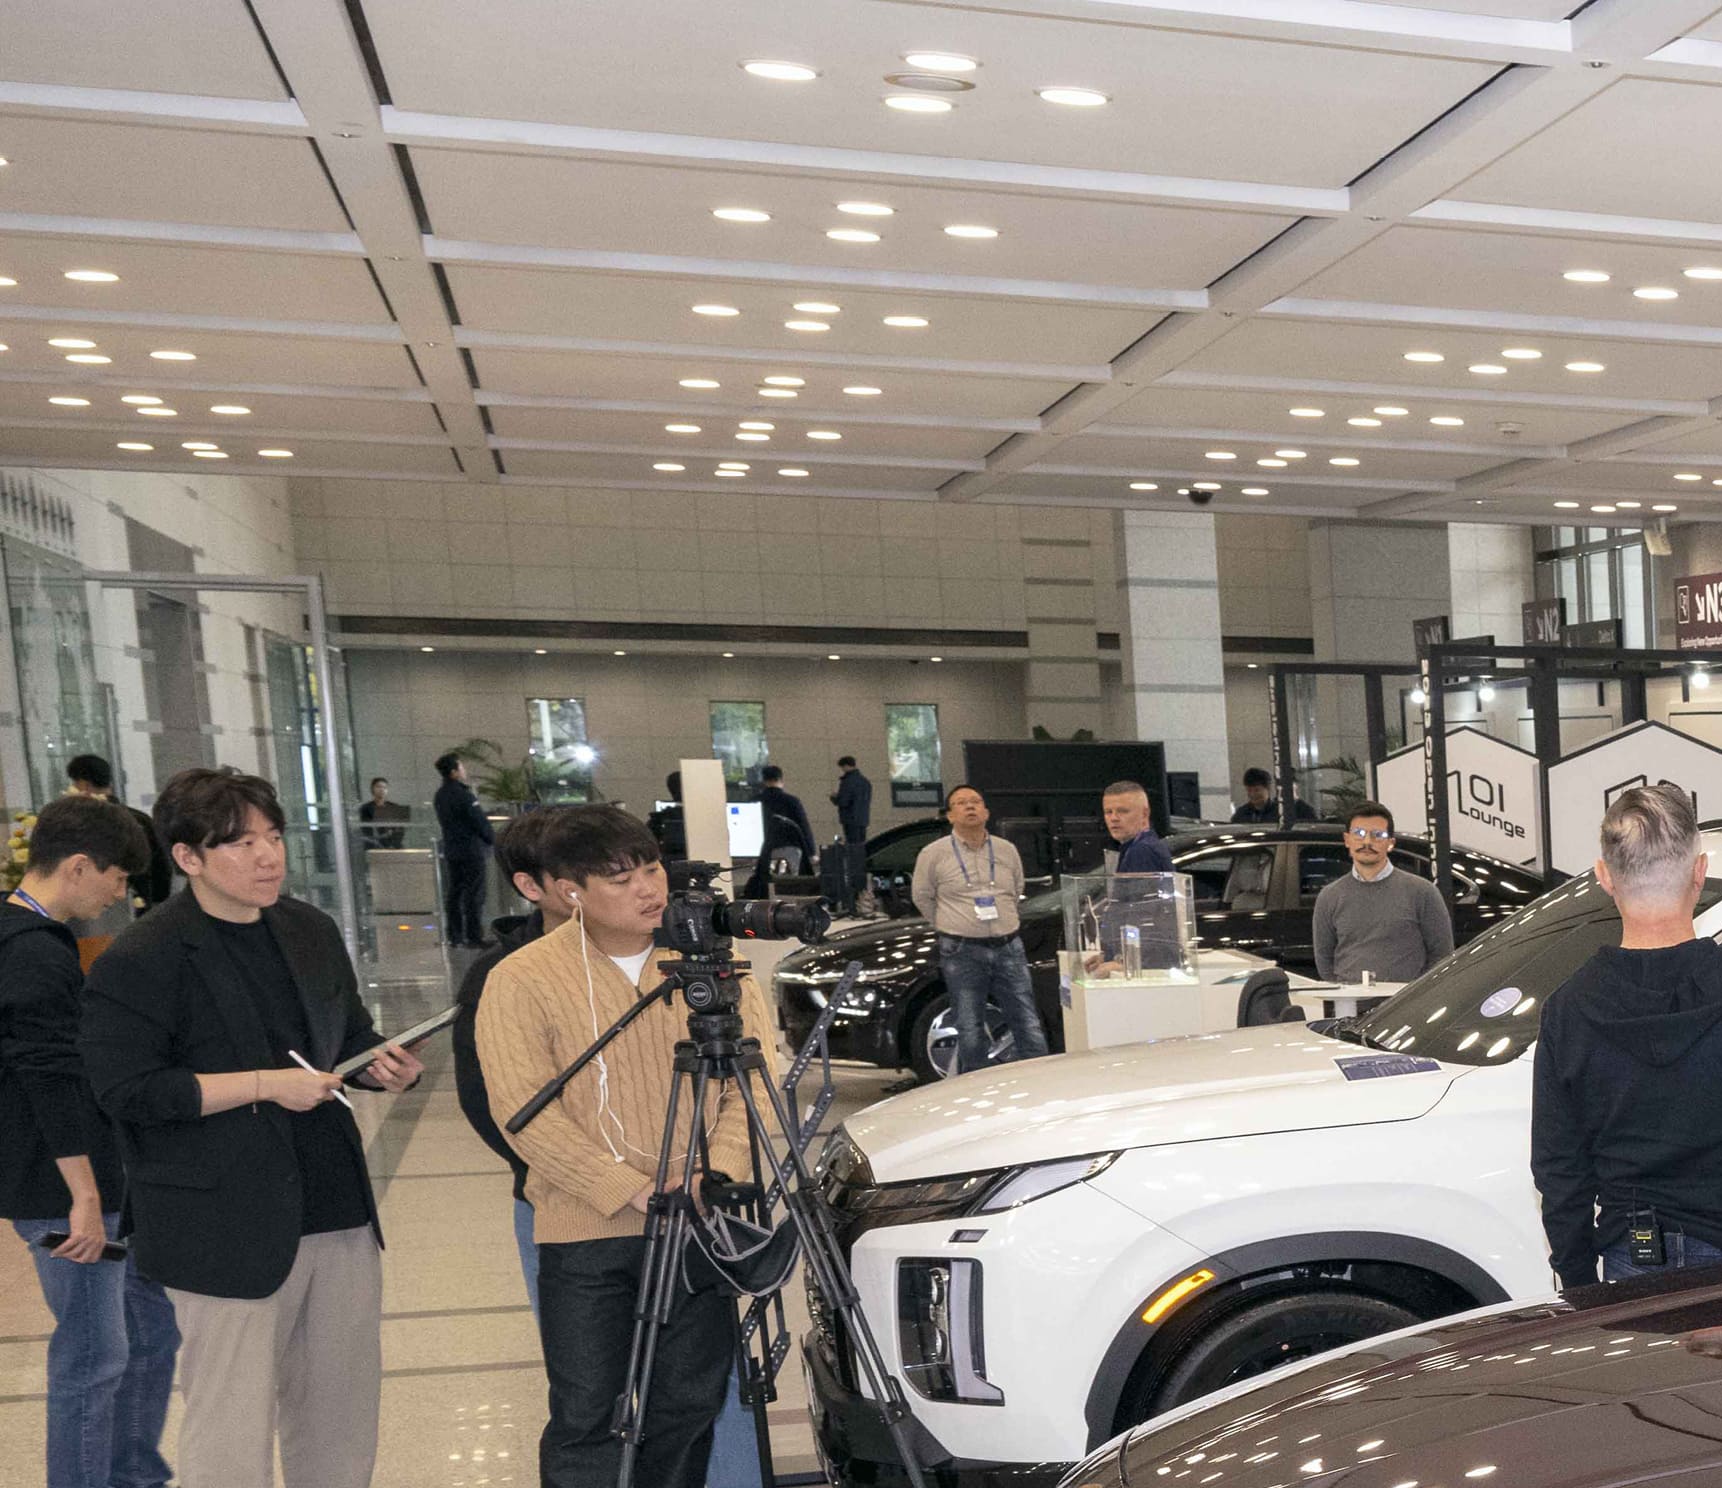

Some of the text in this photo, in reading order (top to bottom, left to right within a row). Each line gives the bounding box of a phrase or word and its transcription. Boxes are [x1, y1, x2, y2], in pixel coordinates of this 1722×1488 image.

[1544, 607, 1560, 643] N2
[1425, 735, 1435, 810] Open
[1428, 817, 1438, 885] Inno
